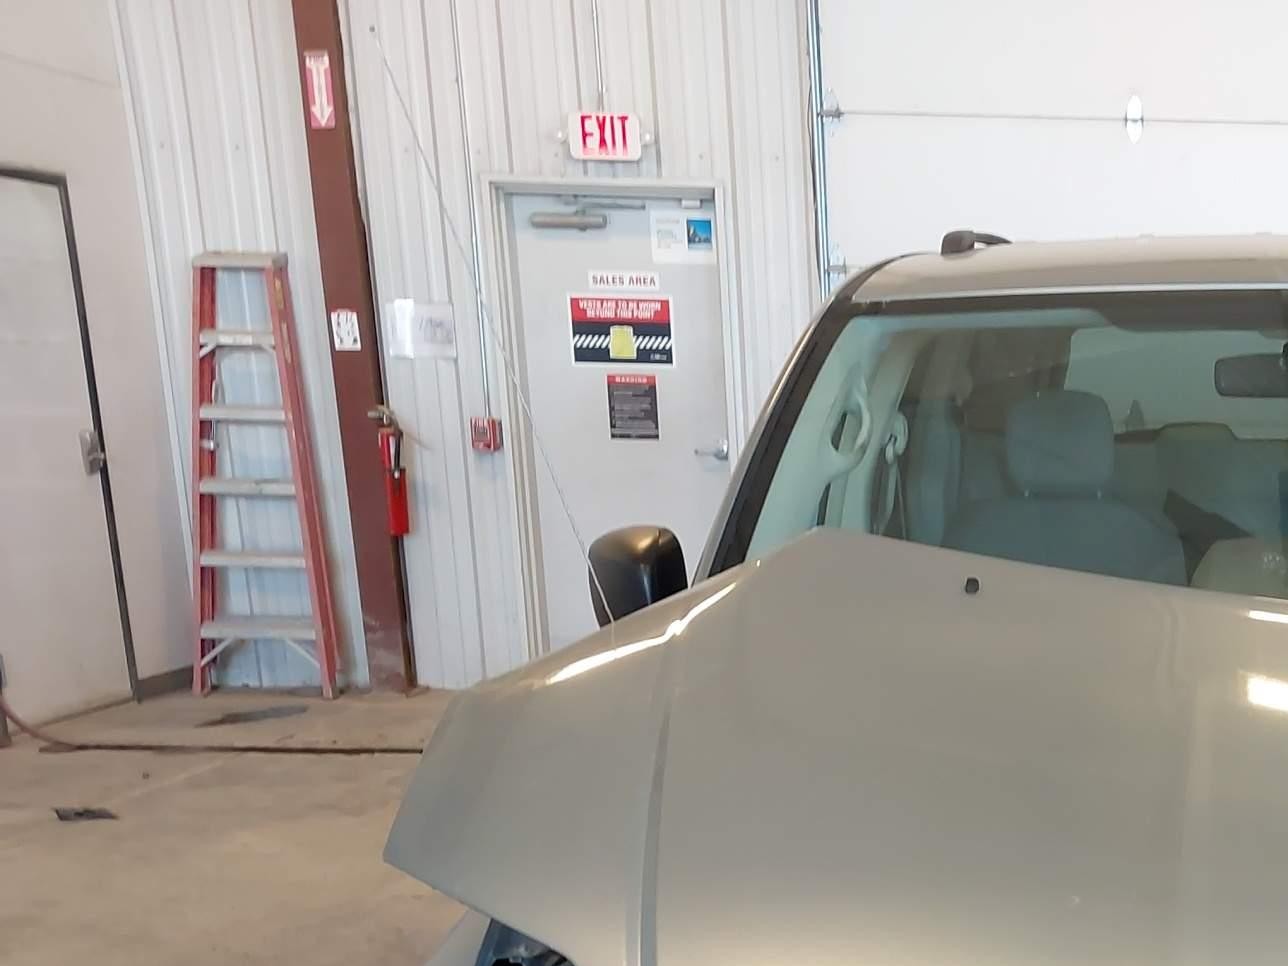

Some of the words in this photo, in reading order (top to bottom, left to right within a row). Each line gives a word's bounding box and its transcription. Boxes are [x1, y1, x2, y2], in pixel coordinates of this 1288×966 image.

[580, 115, 628, 156] EXIT
[592, 275, 625, 287] SALES
[628, 276, 656, 287] AREA
